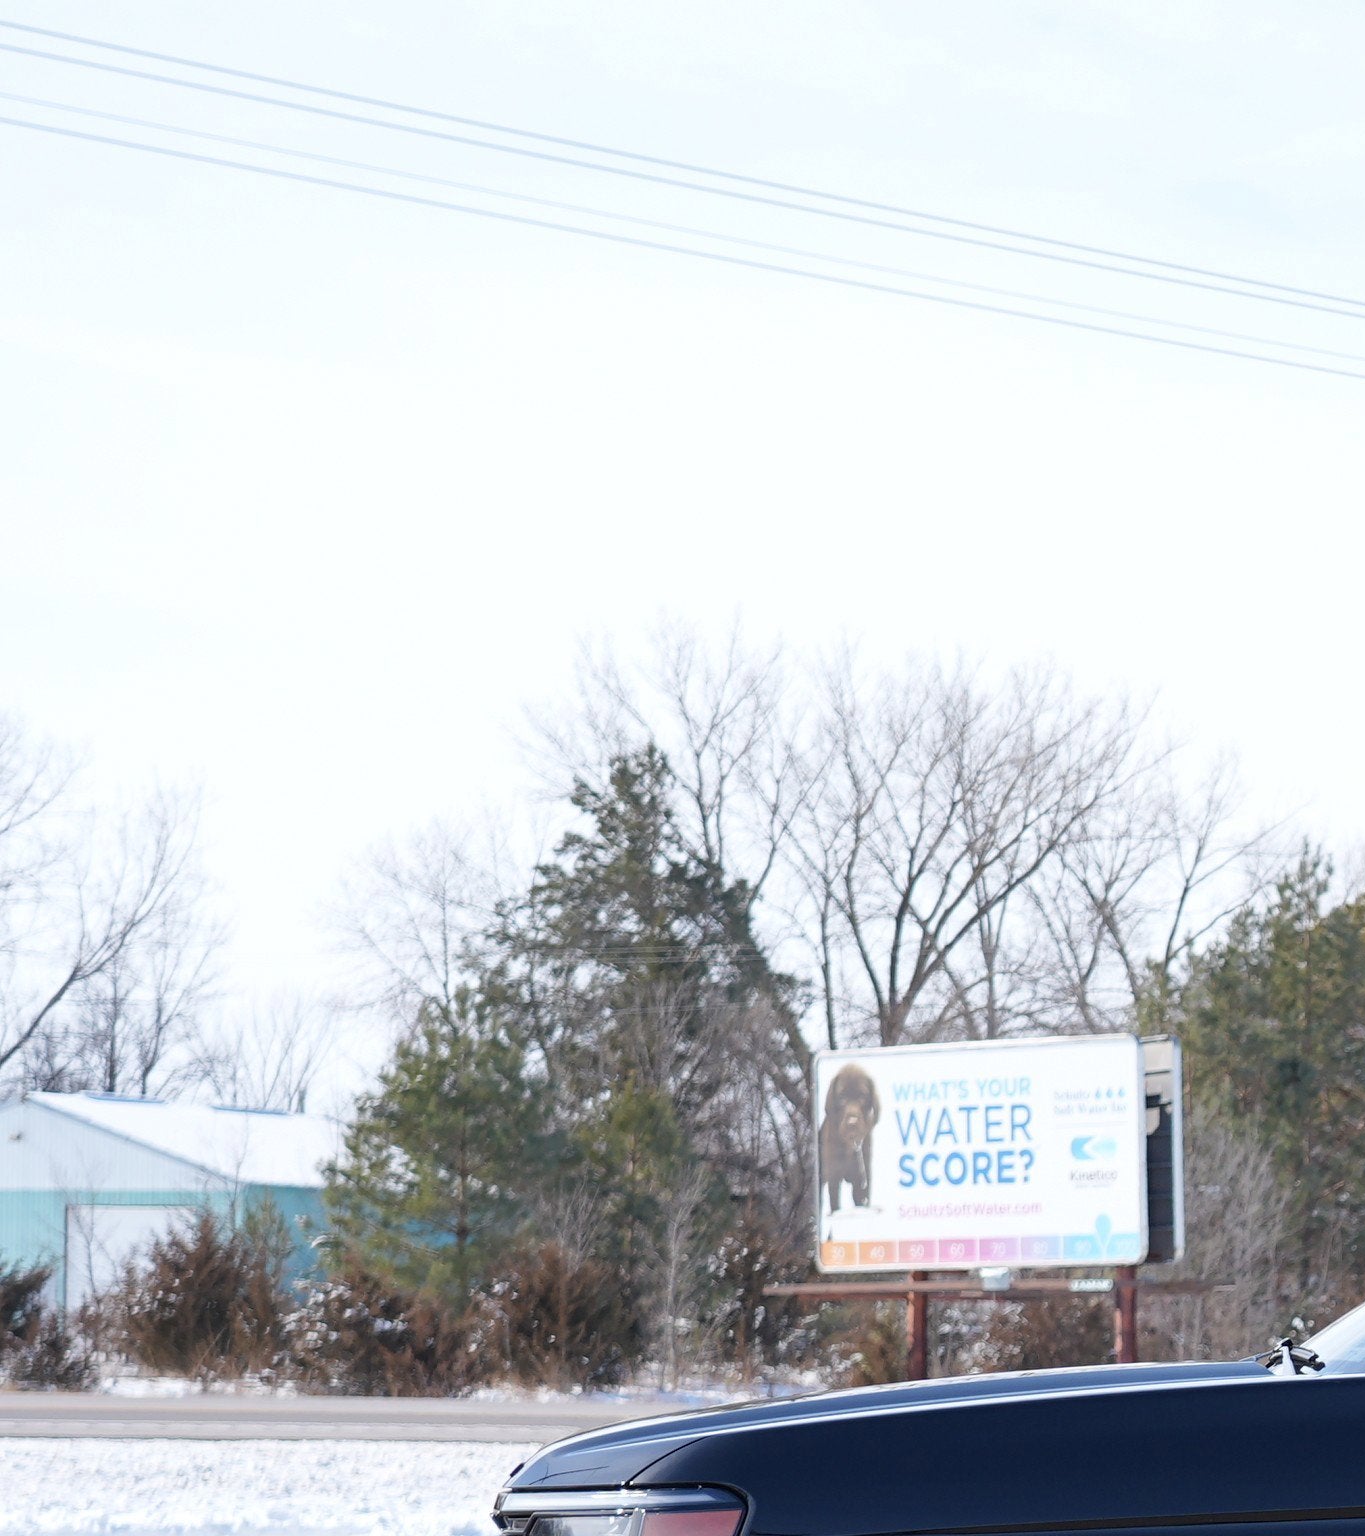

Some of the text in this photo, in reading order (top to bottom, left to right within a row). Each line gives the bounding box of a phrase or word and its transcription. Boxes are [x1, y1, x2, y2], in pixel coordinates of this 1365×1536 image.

[893, 1077, 1031, 1101] WHAT'S YOUR
[895, 1104, 1033, 1146] WATER
[899, 1149, 1035, 1187] SCORE?
